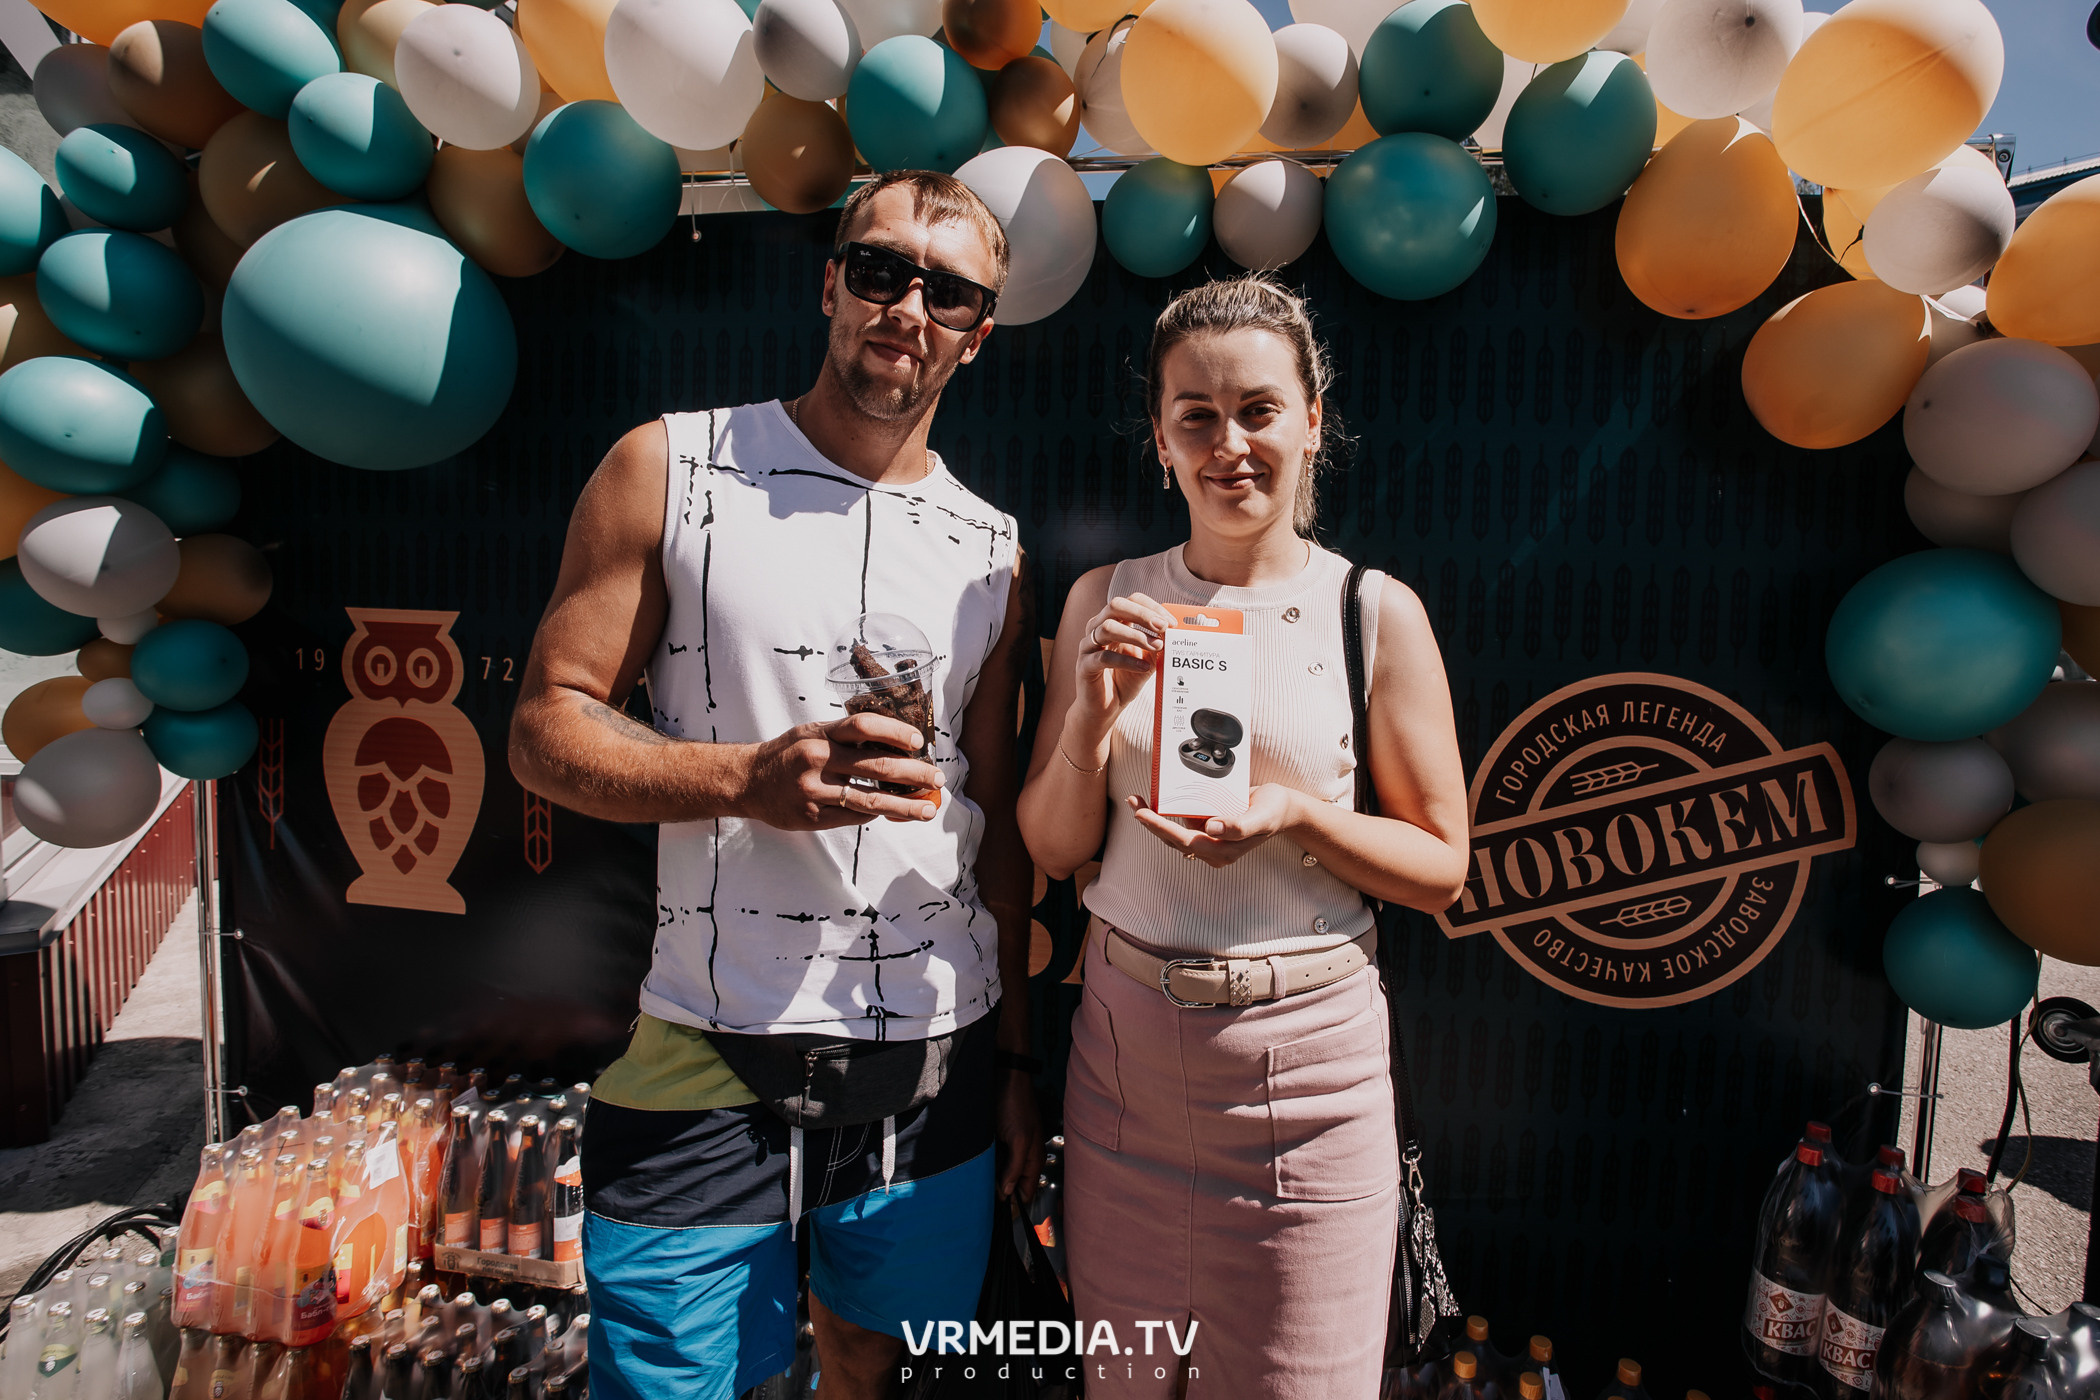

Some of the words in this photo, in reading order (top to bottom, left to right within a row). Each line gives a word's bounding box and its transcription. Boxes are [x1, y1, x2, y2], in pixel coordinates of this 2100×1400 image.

[1172, 638, 1198, 647] aceline
[295, 648, 325, 671] 19
[481, 656, 514, 682] 72
[1172, 657, 1214, 671] BASIC
[1218, 660, 1227, 672] S
[1495, 703, 1611, 805] ГОРОДСКАЯ
[1621, 701, 1728, 754] ЛЕГЕНДА
[1461, 769, 1828, 914] НОВОКЕМ
[1660, 876, 1775, 980] ЗАВОДСКОЕ
[1533, 929, 1651, 983] КАЧЕСТВО
[1767, 1320, 1817, 1339] КВАС
[1823, 1341, 1872, 1369] КВАС
